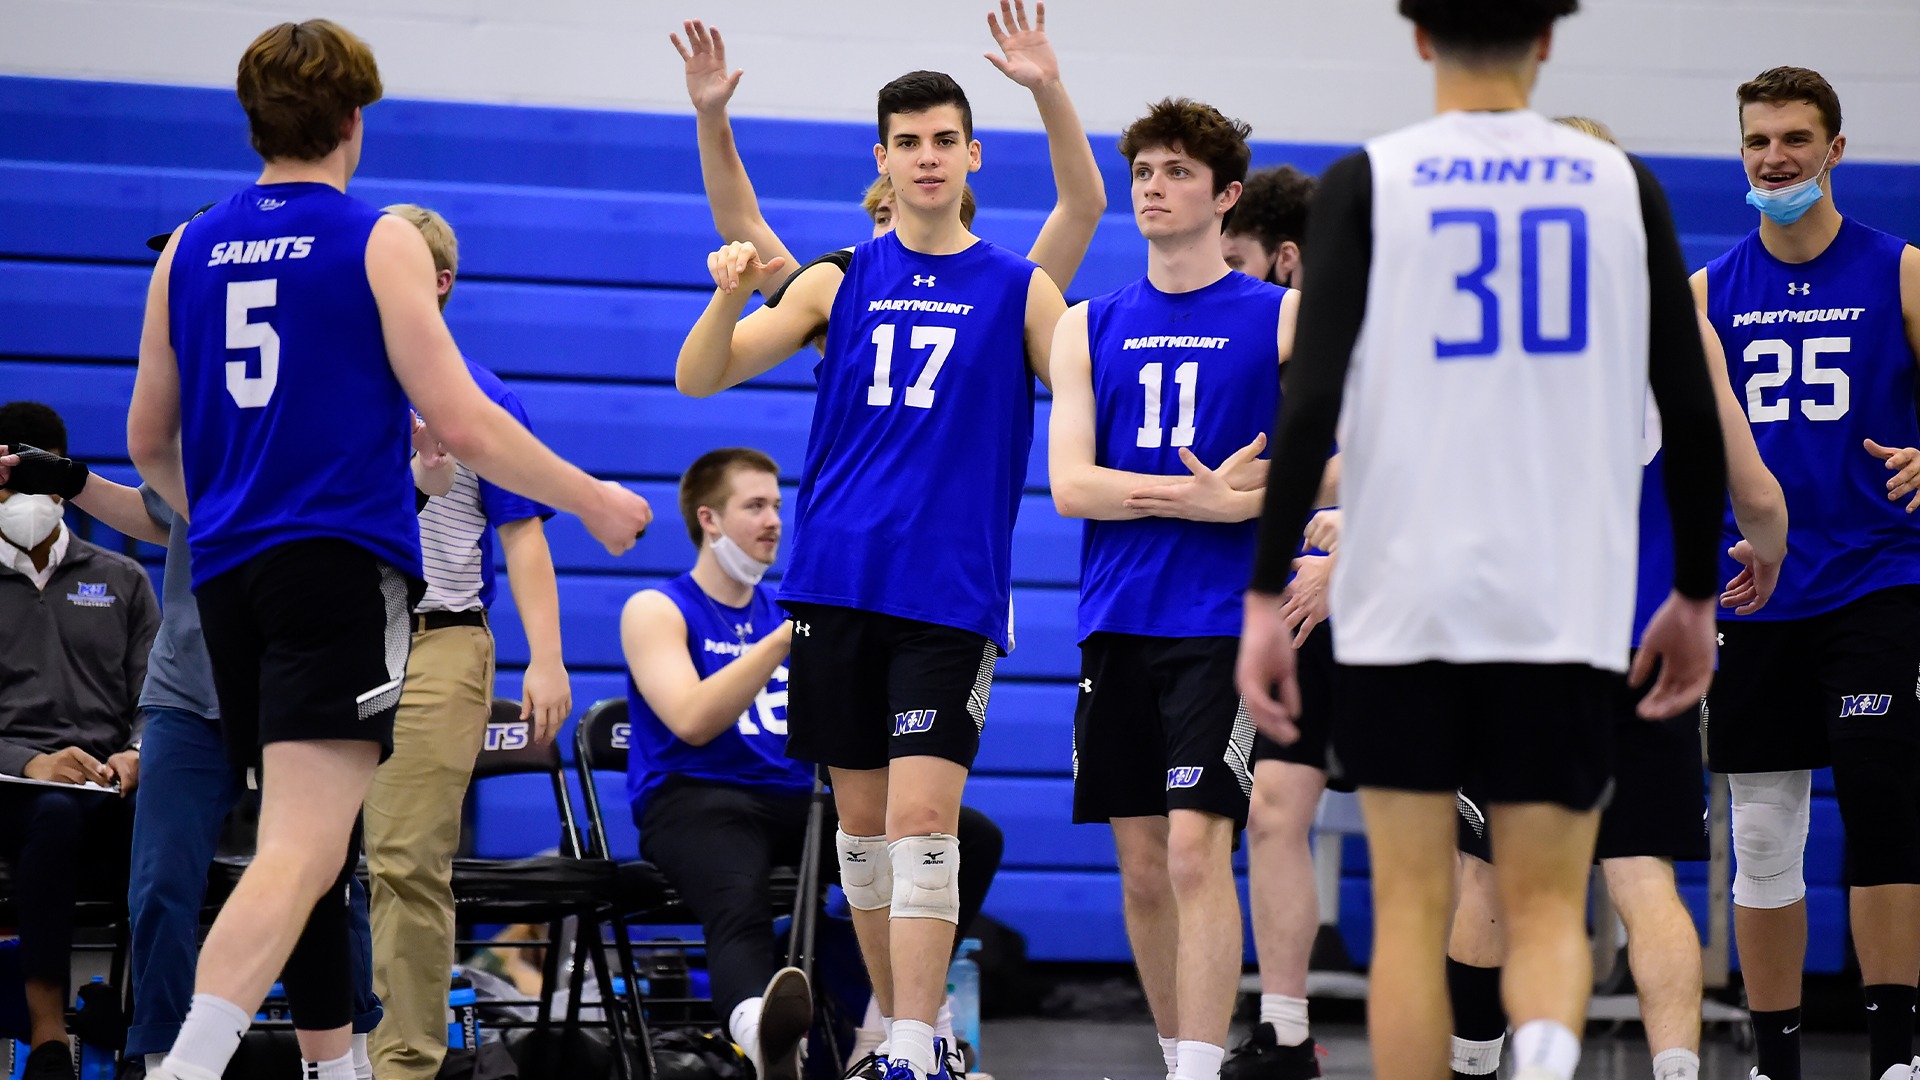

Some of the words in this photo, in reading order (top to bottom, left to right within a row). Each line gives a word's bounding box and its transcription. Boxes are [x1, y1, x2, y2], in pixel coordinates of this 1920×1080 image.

[1412, 156, 1594, 186] SAINTS
[207, 236, 315, 267] SAINTS
[1430, 206, 1588, 361] 30
[868, 299, 974, 315] MARYMOUNT
[1732, 308, 1866, 328] MARYMOUNT
[225, 278, 280, 409] 5
[1122, 335, 1230, 350] MARYMOUNT
[867, 323, 957, 409] 17
[1743, 336, 1851, 423] 25
[1136, 361, 1199, 448] 11
[1839, 694, 1893, 718] MU
[484, 722, 529, 751] TS
[892, 709, 938, 737] MU
